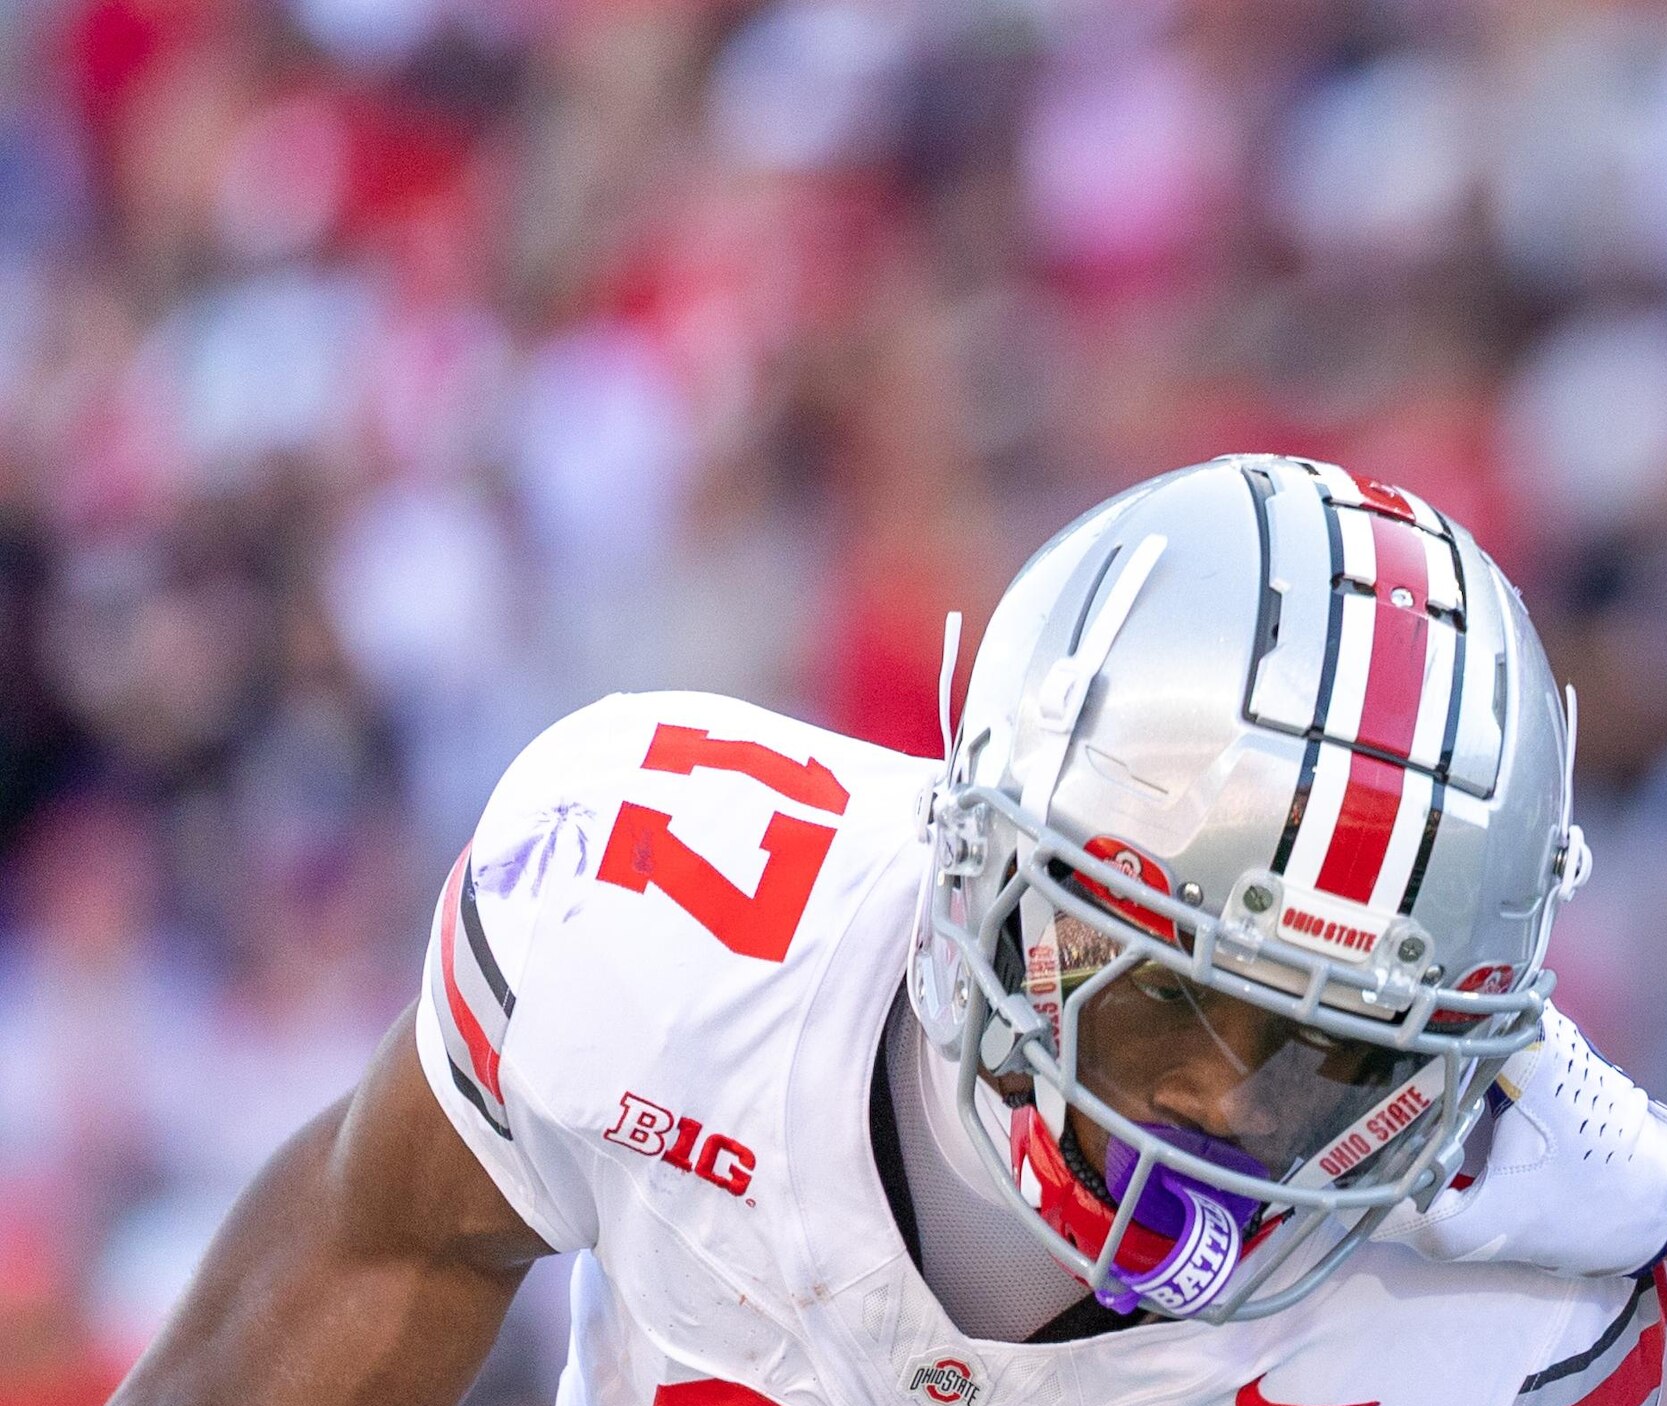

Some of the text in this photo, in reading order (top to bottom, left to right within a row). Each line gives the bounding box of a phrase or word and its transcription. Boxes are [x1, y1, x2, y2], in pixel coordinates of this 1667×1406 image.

[595, 722, 851, 964] 17
[1283, 907, 1377, 953] OHIO STATE
[1319, 1086, 1430, 1176] OHIO STATE
